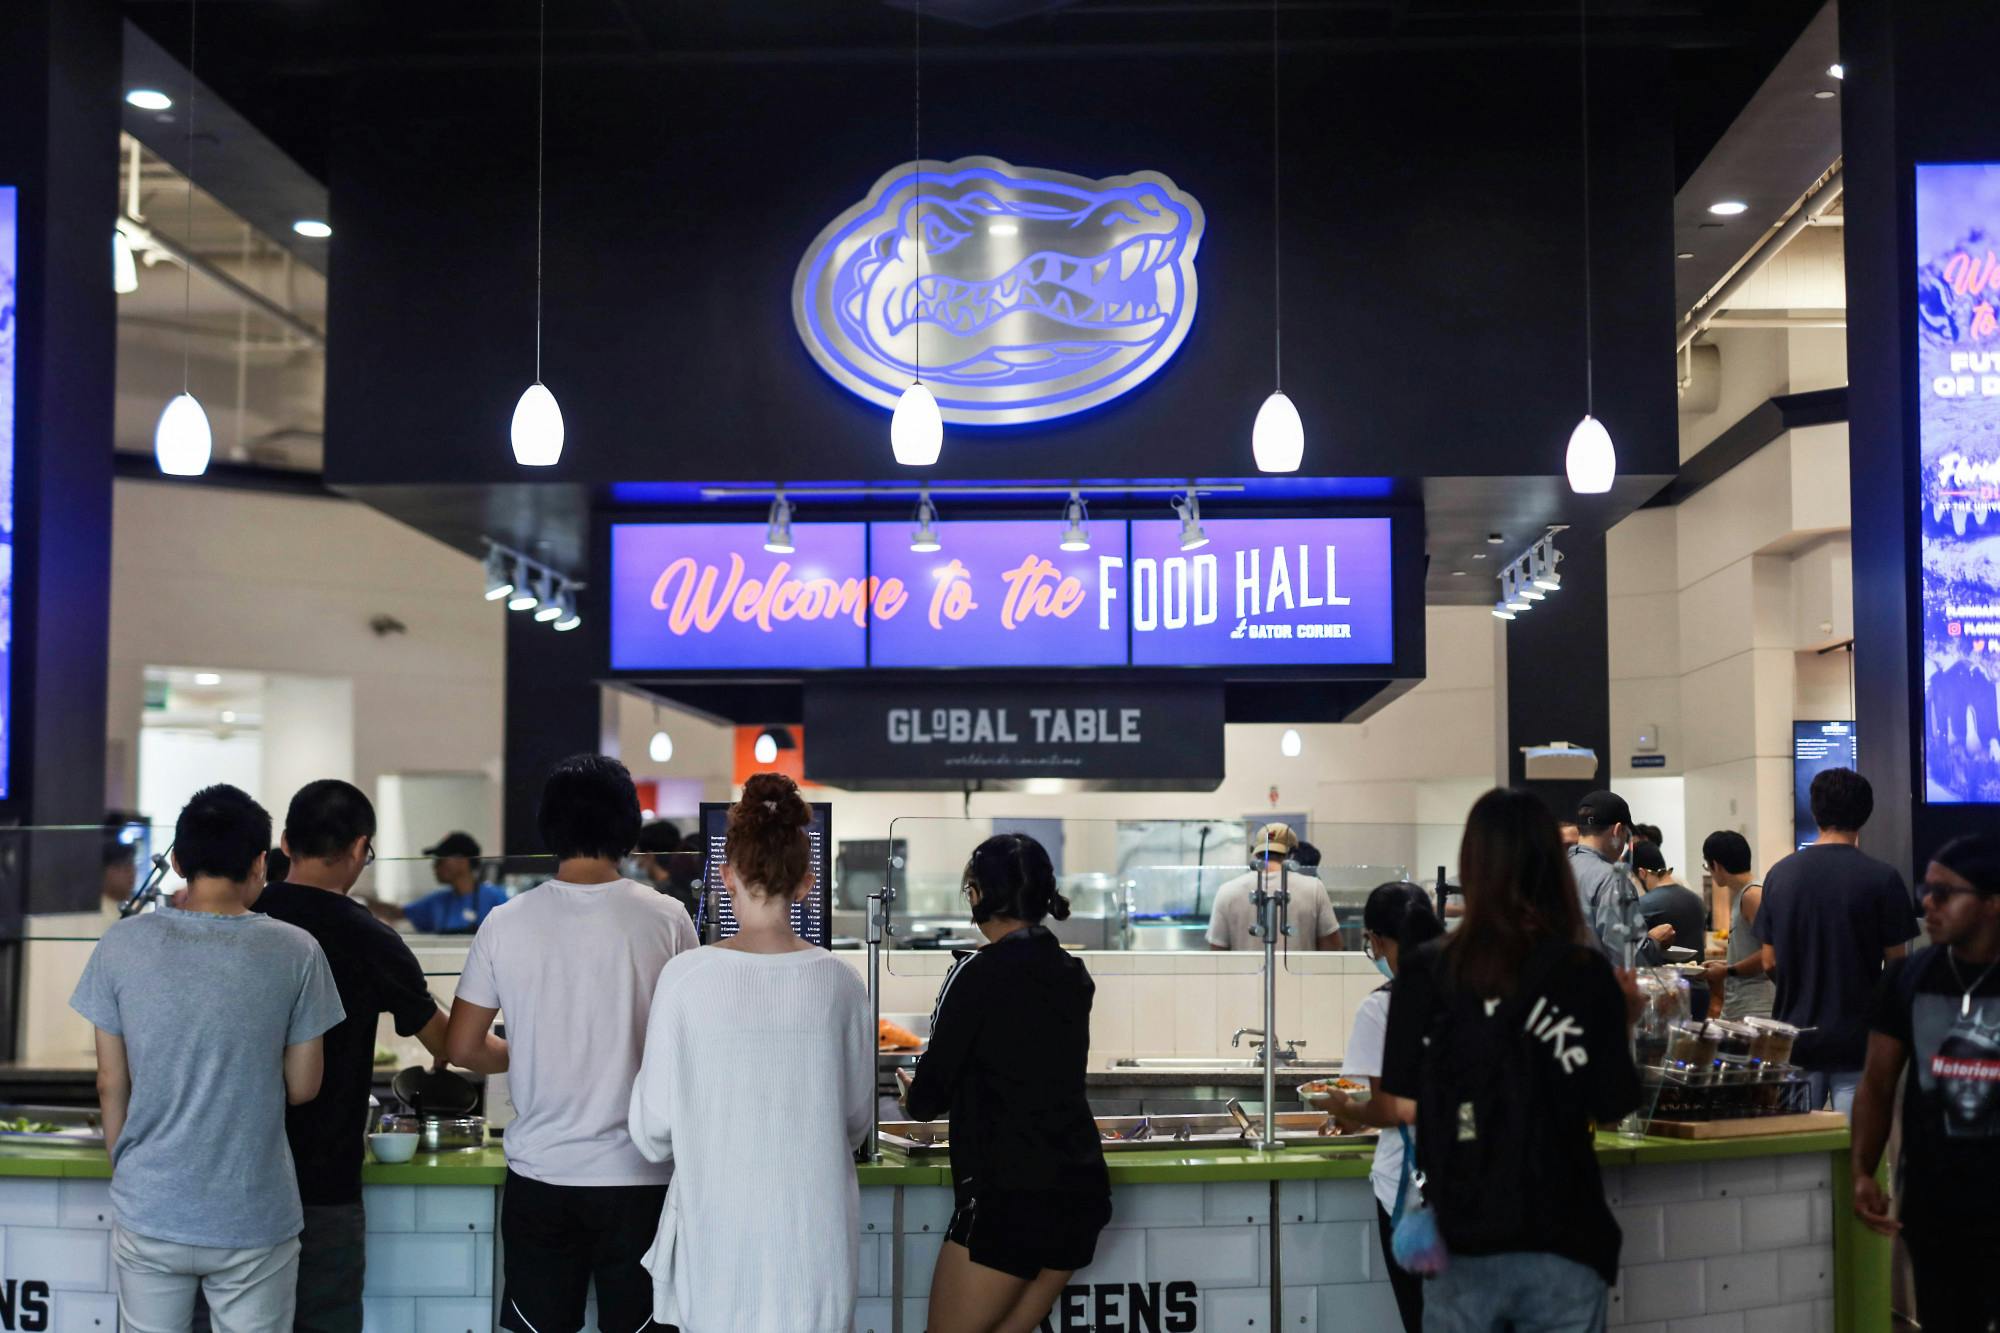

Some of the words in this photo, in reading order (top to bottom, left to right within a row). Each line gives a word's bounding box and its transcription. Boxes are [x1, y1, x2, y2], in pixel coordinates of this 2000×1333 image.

[1970, 300, 2000, 341] to
[1933, 376, 1975, 397] OF
[651, 552, 908, 636] Welcome
[928, 559, 978, 630] to
[1001, 554, 1086, 630] the
[1099, 554, 1217, 632] FOOD
[1235, 544, 1350, 619] HALL
[1230, 618, 1247, 639] at
[1248, 624, 1293, 639] GATOR
[1296, 624, 1351, 639] CORNER
[887, 709, 1018, 743] GLOBAL
[1030, 709, 1141, 743] TABLE
[1932, 1058, 2000, 1078] Notoriou
